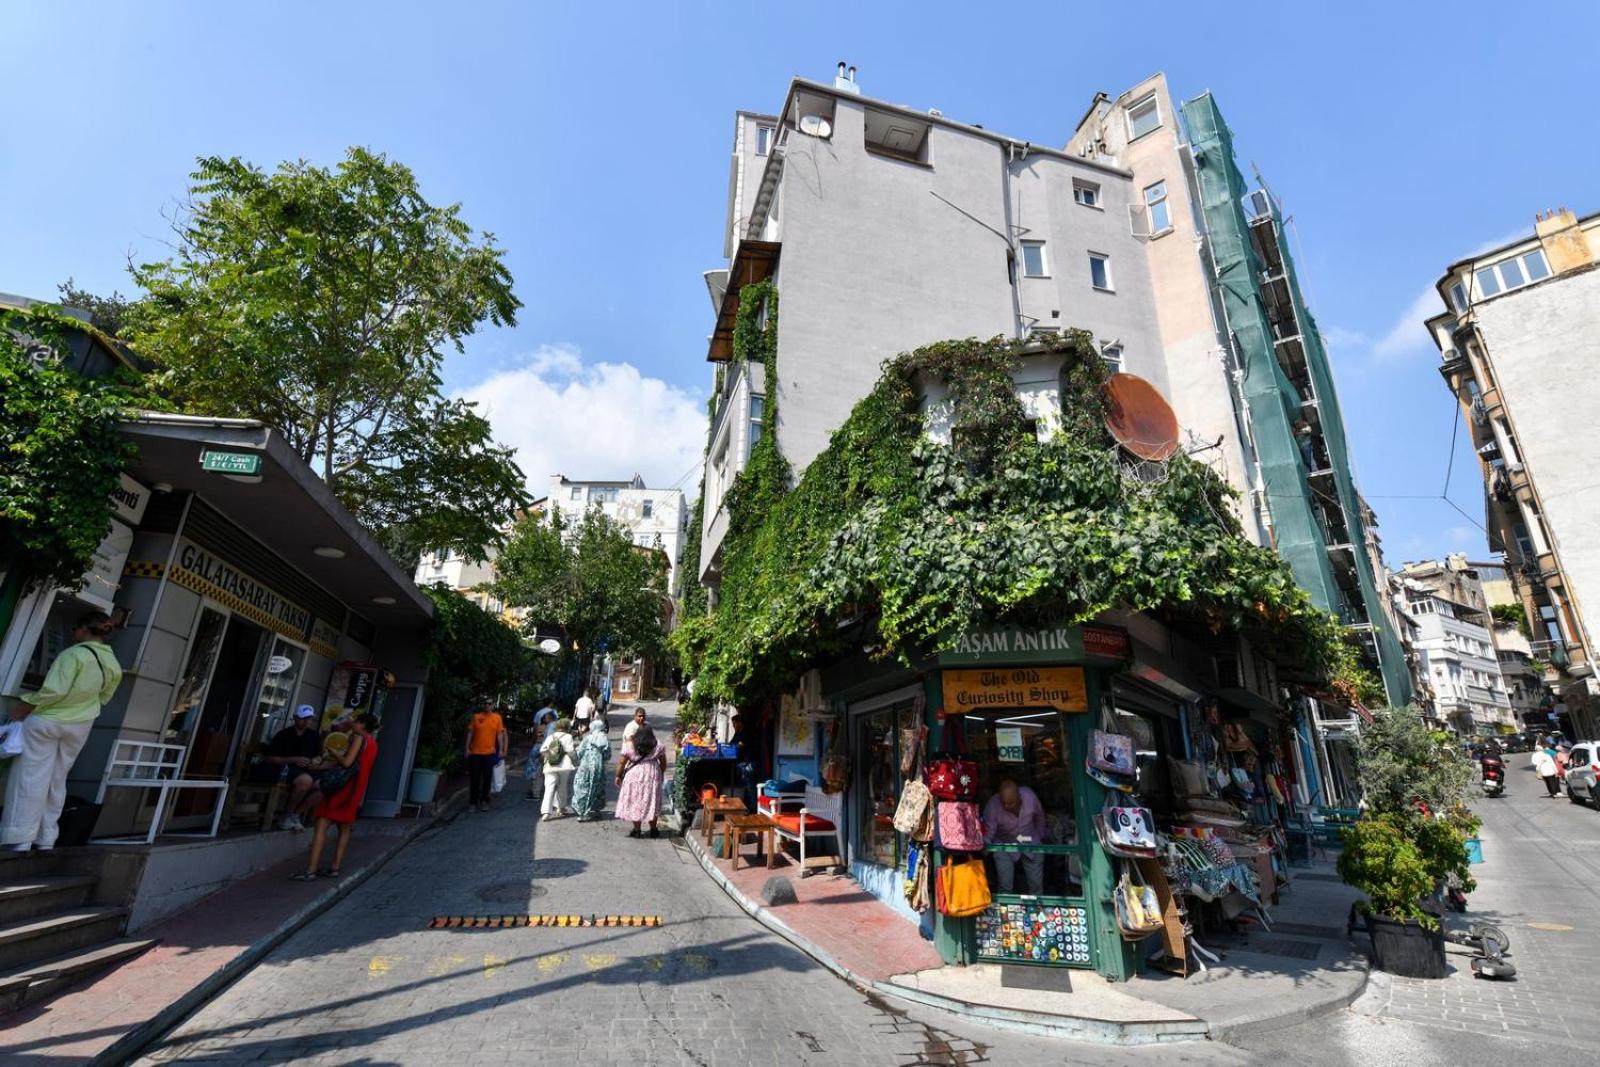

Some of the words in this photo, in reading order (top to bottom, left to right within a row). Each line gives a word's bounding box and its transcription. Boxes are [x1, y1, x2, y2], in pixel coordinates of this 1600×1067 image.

[180, 545, 278, 614] GALATASARAY
[954, 632, 1009, 659] AŞAM
[350, 672, 368, 707] Cappy
[980, 672, 1008, 688] The
[1012, 670, 1040, 685] Old
[957, 691, 1024, 706] Curiosity
[1029, 687, 1069, 703] Shop
